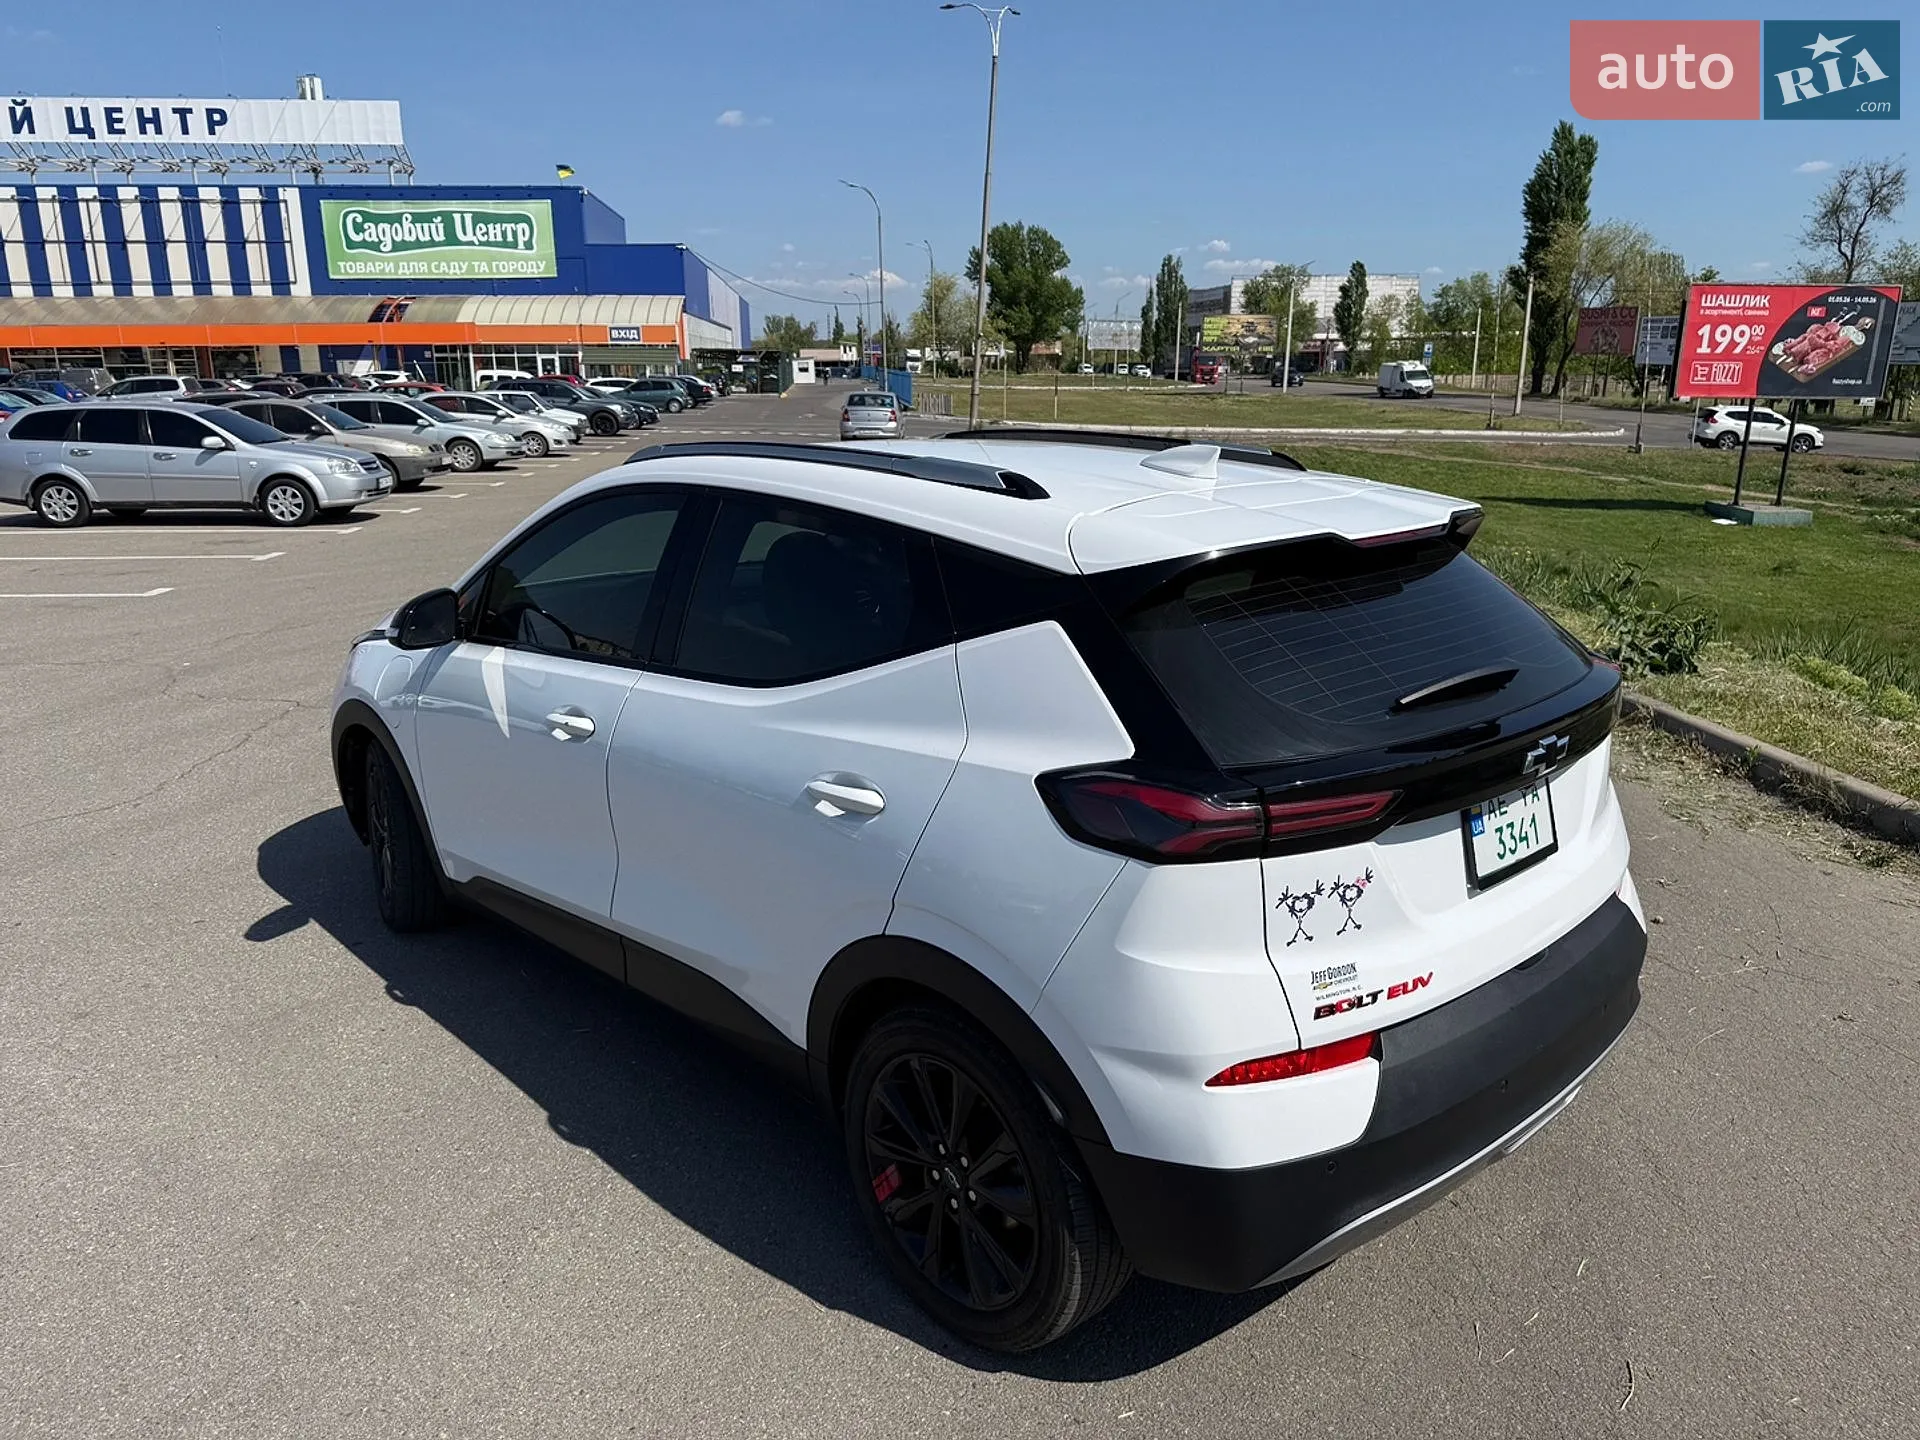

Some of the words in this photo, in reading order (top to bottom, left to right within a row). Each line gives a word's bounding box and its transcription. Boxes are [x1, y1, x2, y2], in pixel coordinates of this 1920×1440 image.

[64, 106, 228, 139] ЦЕНТР
[346, 212, 446, 252] Садовий
[452, 213, 530, 250] Центр
[337, 261, 395, 273] ТОВАРИ
[398, 262, 427, 275] ДЛЯ
[431, 261, 468, 274] САДУ
[471, 261, 489, 273] ТА
[492, 260, 547, 275] ГОРОДУ
[1701, 294, 1771, 308] ШАШЛИК
[611, 329, 639, 339] ВХІД
[1696, 324, 1751, 354] 199
[1711, 362, 1740, 382] FOZZY
[1472, 819, 1485, 833] UA
[1495, 812, 1540, 860] 3341
[1313, 989, 1384, 1020] BOLT
[1386, 971, 1434, 1001] EUV
